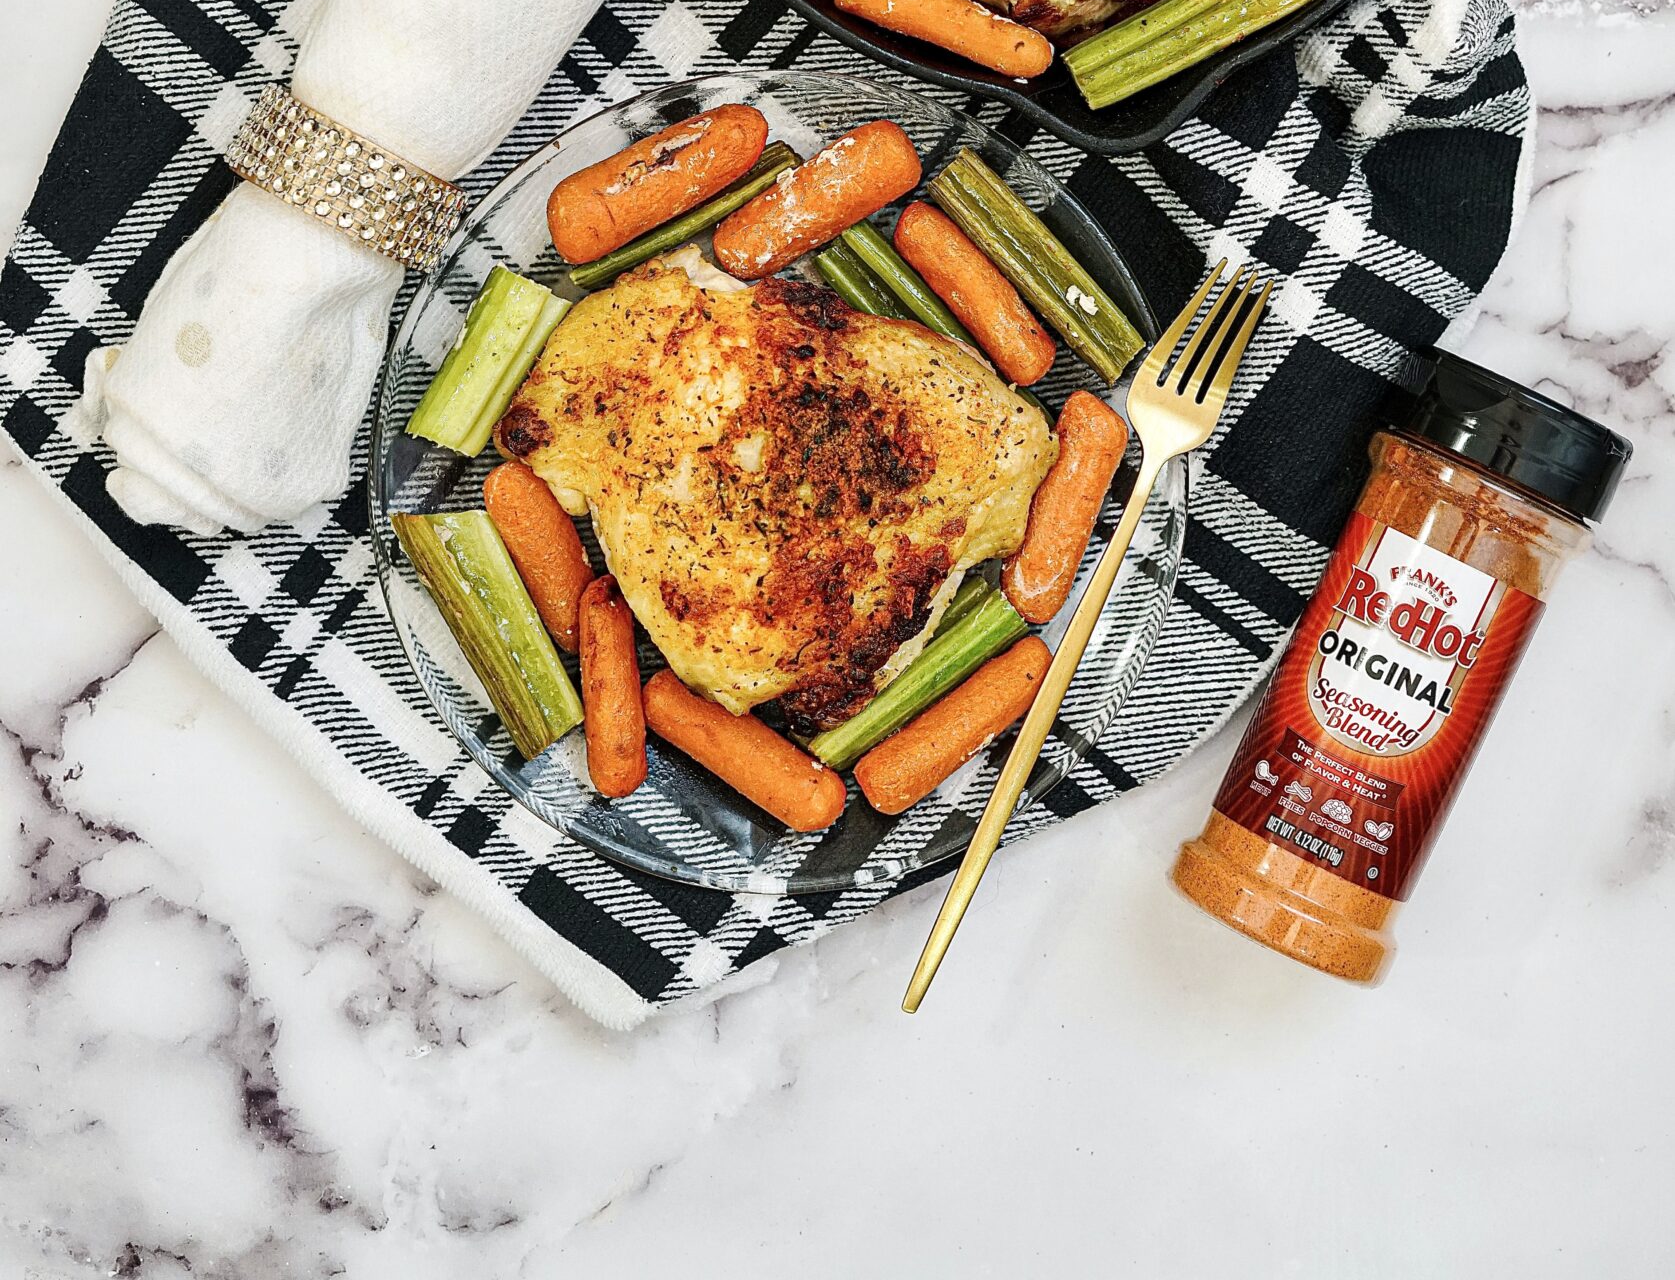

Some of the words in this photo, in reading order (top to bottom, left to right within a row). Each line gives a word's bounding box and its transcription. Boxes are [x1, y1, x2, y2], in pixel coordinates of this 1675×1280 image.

[1404, 581, 1423, 590] INCE
[1335, 566, 1483, 667] RedHot
[1319, 630, 1452, 714] ORIGINAL
[1313, 677, 1421, 748] Seasoning
[1325, 706, 1390, 752] Blend
[1291, 752, 1304, 764] OF
[1303, 759, 1341, 784] FLAVOR
[1341, 779, 1351, 789] &
[1297, 739, 1314, 755] THE
[1314, 748, 1355, 777] PERFECT
[1355, 771, 1387, 791] BLEND
[1250, 780, 1271, 797] MEAT
[1278, 796, 1305, 816] FRIES
[1265, 815, 1283, 833] NET
[1279, 821, 1296, 840] WT
[1294, 830, 1312, 849] 4.12
[1309, 837, 1324, 854] OZ
[1318, 843, 1344, 866] (116g)
[1309, 811, 1353, 840] POPCORN
[1353, 832, 1389, 855] VEGGIES
